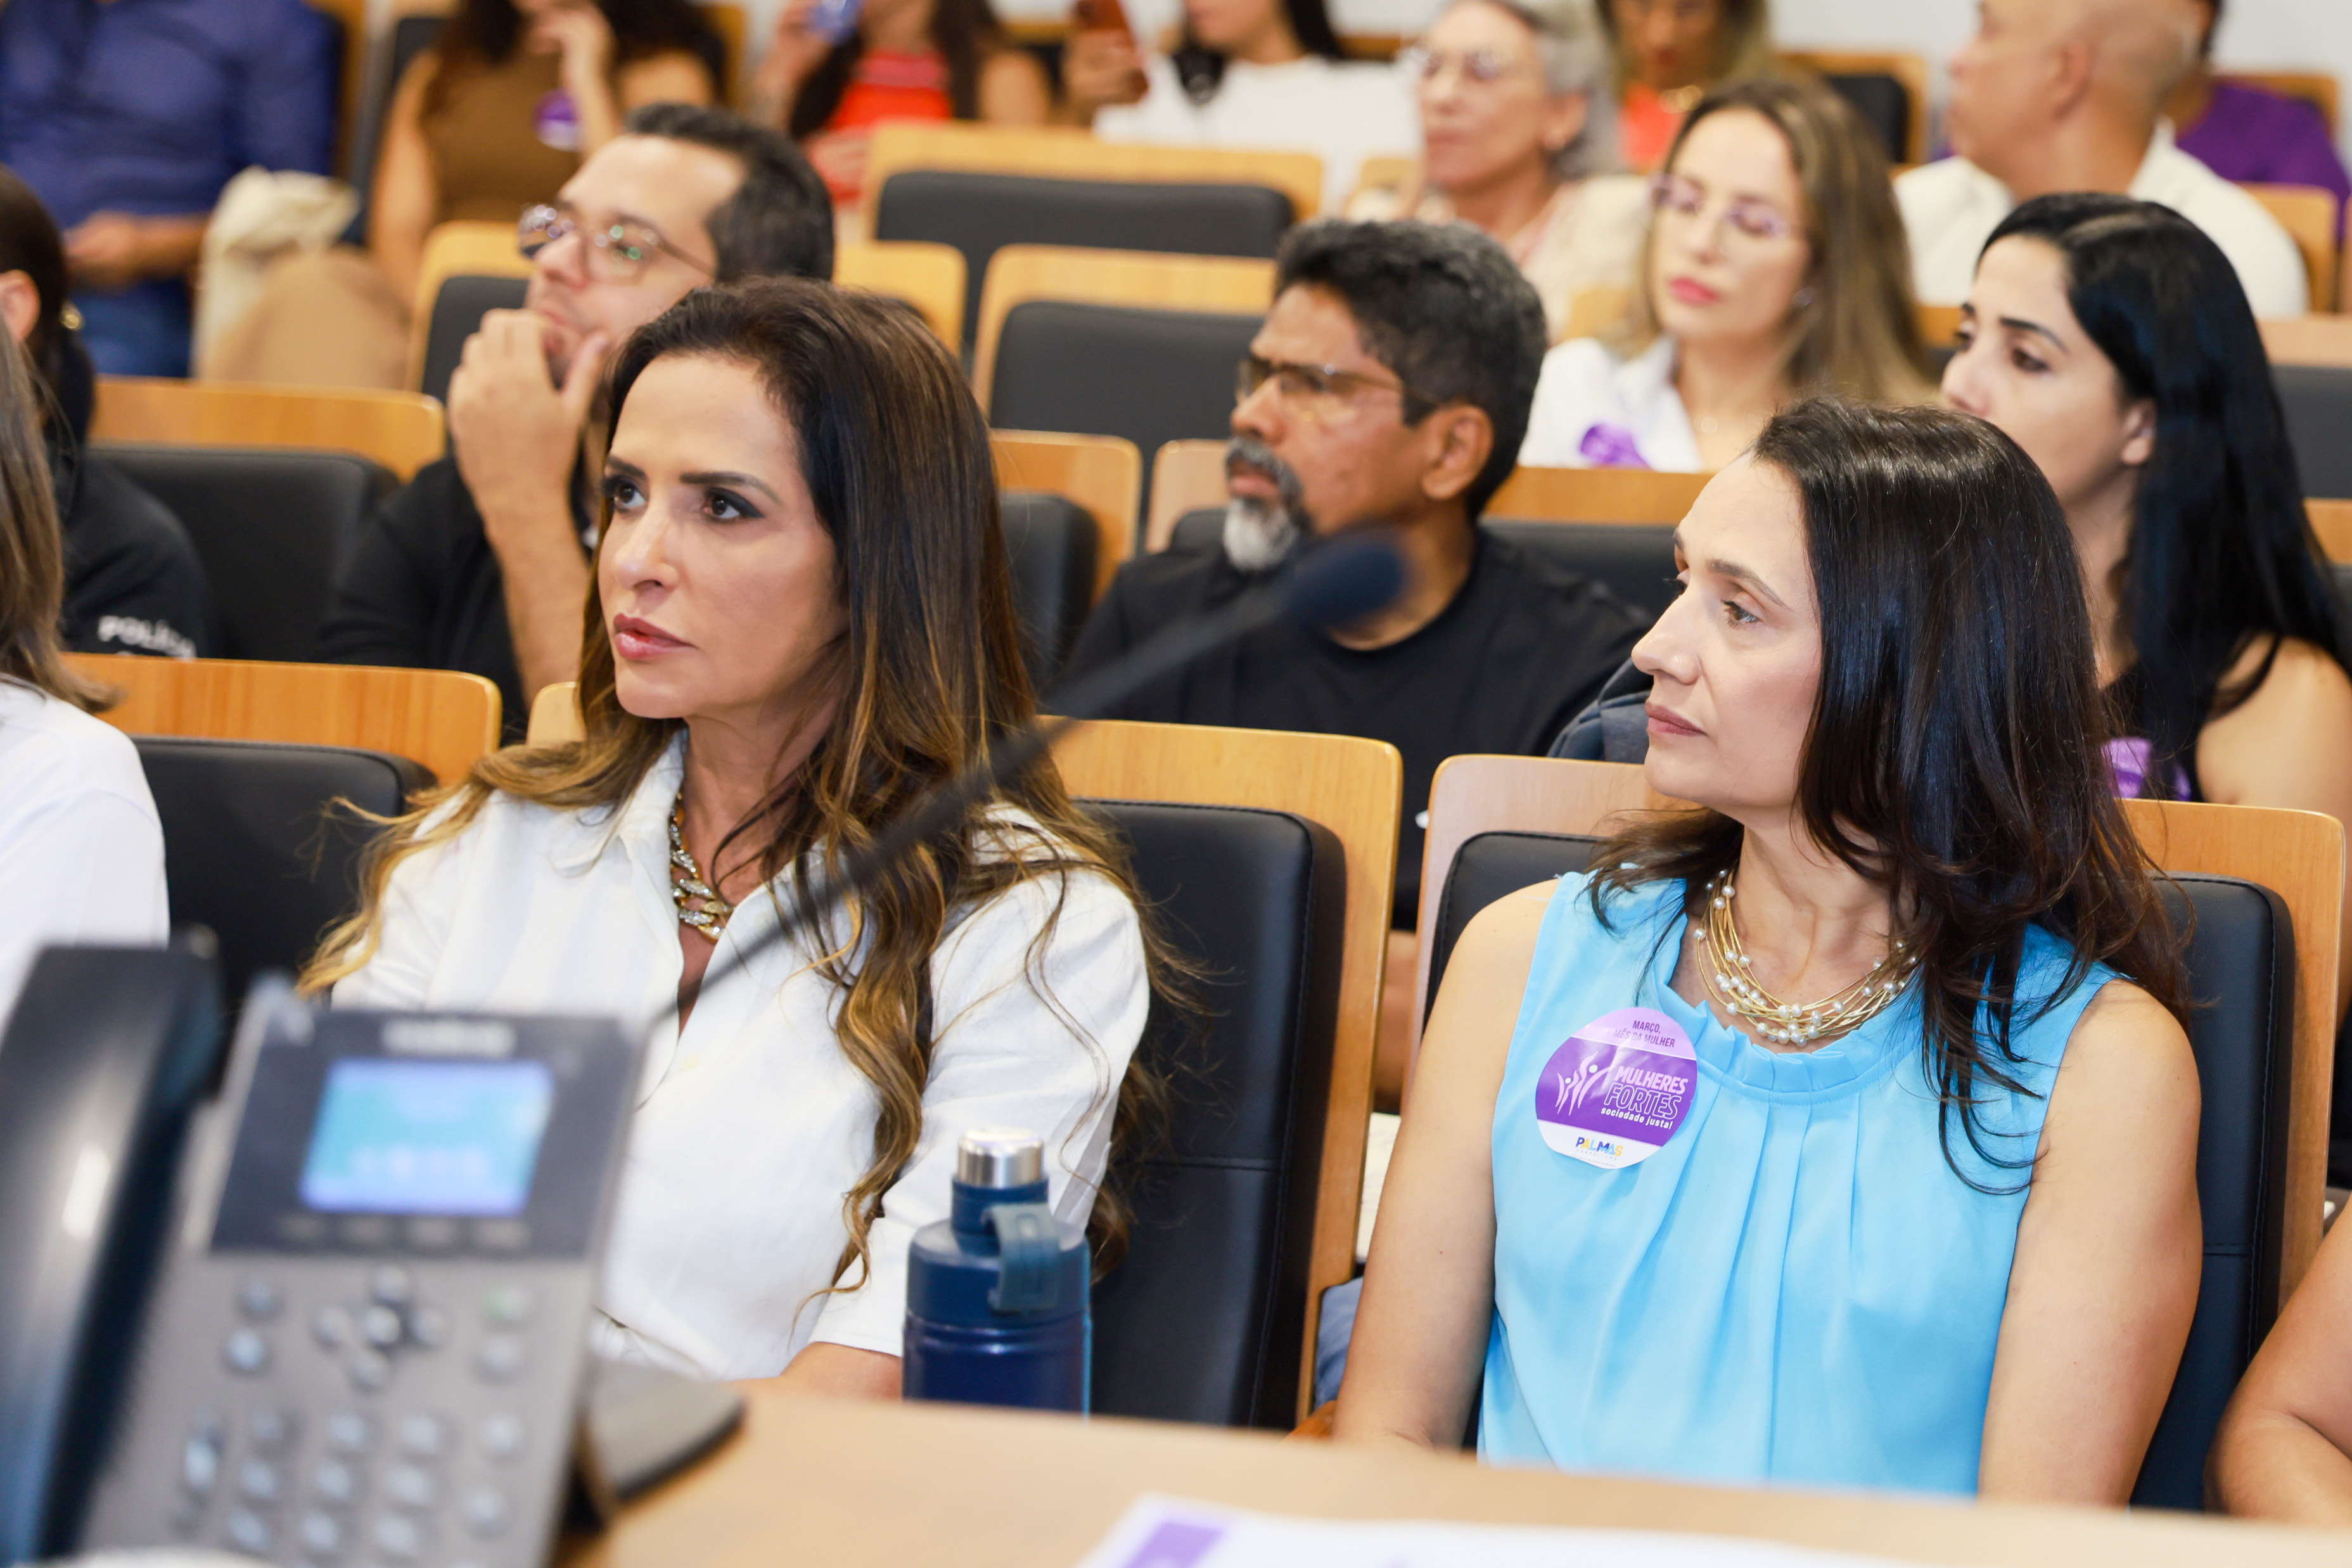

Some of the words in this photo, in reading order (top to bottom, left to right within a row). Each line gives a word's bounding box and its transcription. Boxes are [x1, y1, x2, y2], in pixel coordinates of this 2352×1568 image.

[1613, 1028, 1630, 1038] MÊS
[1644, 1033, 1675, 1048] MULHER
[1632, 1020, 1661, 1035] MARÇO,
[1614, 1066, 1689, 1095] MULHERES
[1603, 1082, 1682, 1120] FORTES
[1601, 1107, 1645, 1124] sociedade
[1645, 1114, 1673, 1130] justa!
[1575, 1137, 1624, 1157] PALMAS
